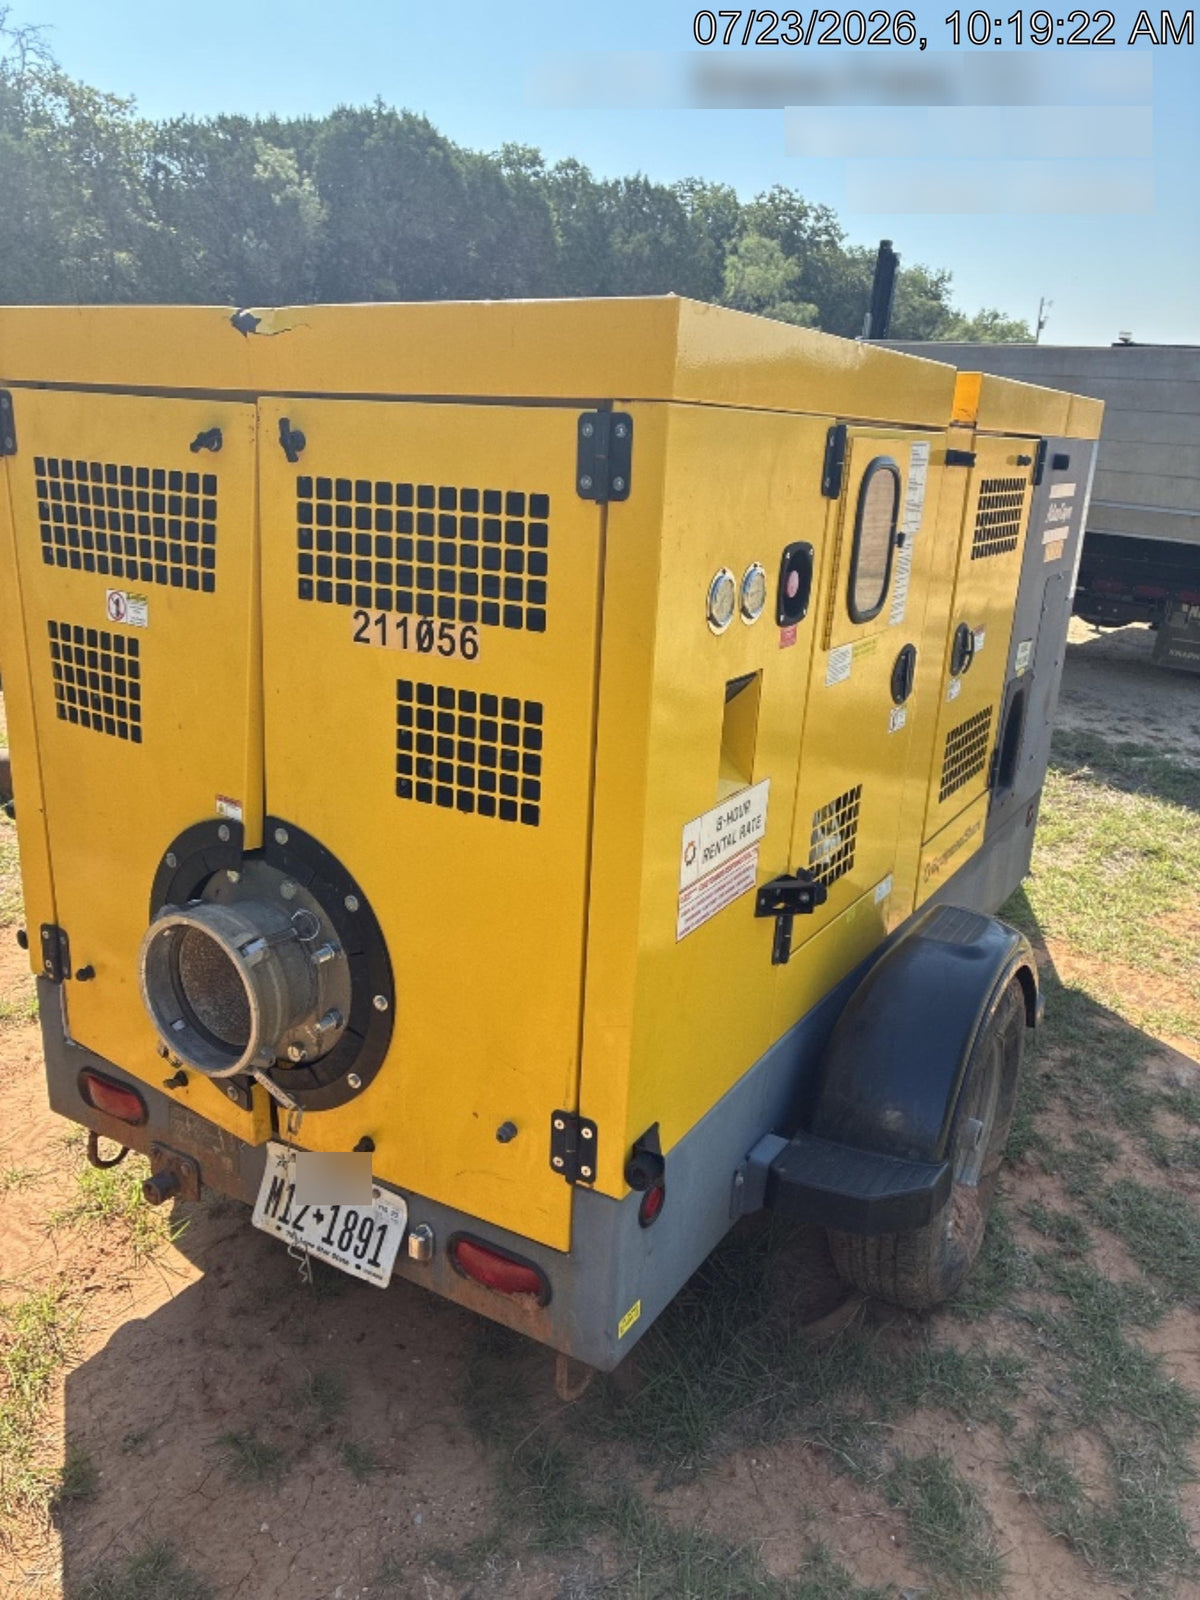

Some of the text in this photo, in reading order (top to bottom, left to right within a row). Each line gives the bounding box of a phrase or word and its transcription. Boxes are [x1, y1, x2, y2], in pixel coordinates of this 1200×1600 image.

[353, 609, 479, 661] 211056
[702, 814, 763, 865] RENTAL RATE
